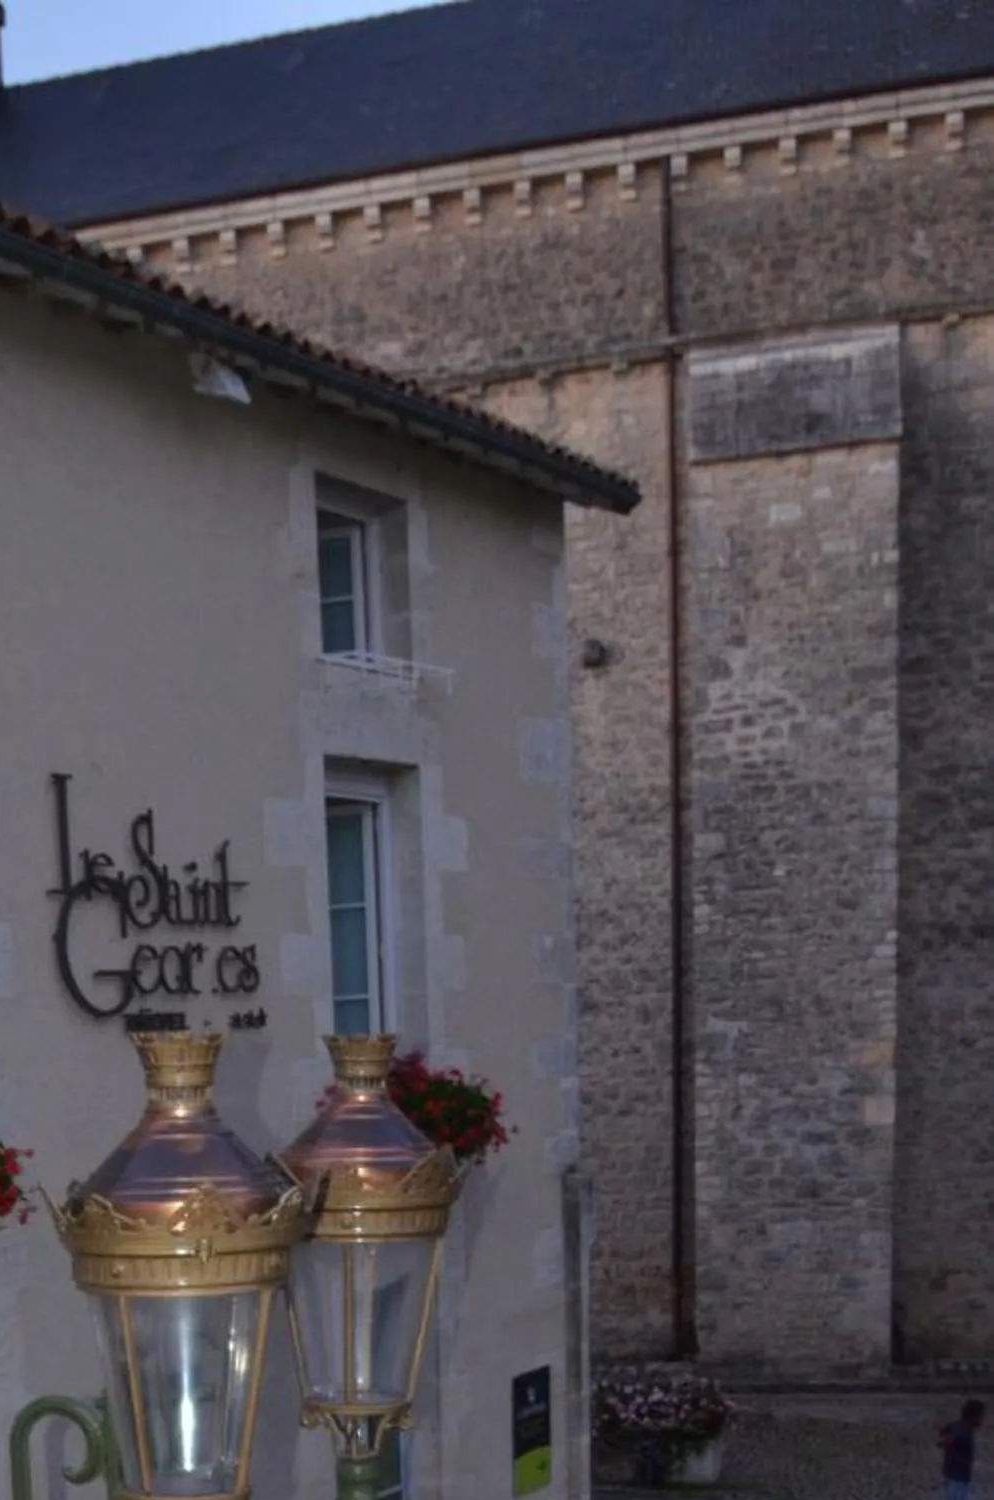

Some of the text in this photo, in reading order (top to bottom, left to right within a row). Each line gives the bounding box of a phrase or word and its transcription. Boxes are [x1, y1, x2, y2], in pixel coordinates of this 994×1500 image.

[46, 773, 249, 929] Le Saint
[52, 872, 262, 1018] Geores
